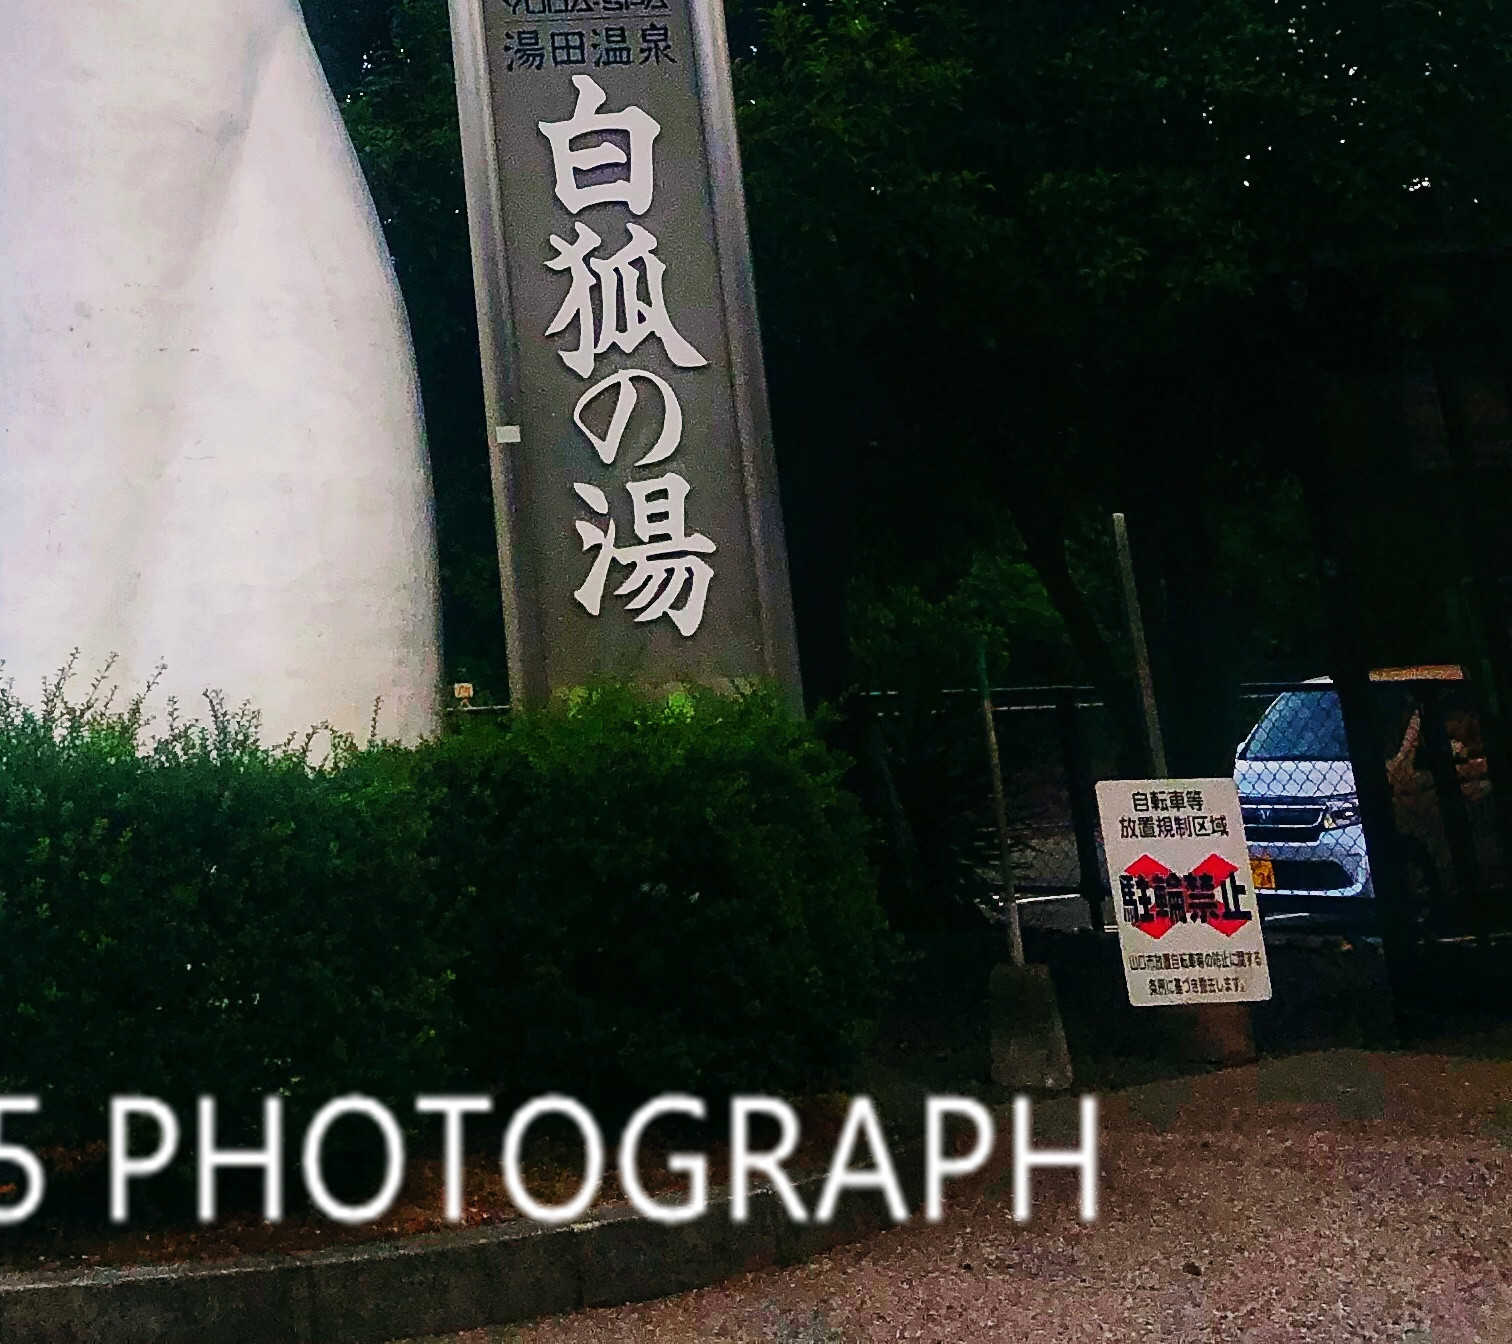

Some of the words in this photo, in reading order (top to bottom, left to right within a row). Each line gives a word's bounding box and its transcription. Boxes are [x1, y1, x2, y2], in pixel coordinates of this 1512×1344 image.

[503, 23, 678, 72] 湯田温泉
[538, 73, 716, 638] 白狐の湯
[1131, 790, 1204, 813] 自転車等
[1119, 814, 1230, 839] 放置規制区域
[1119, 871, 1253, 924] 駐輪禁止
